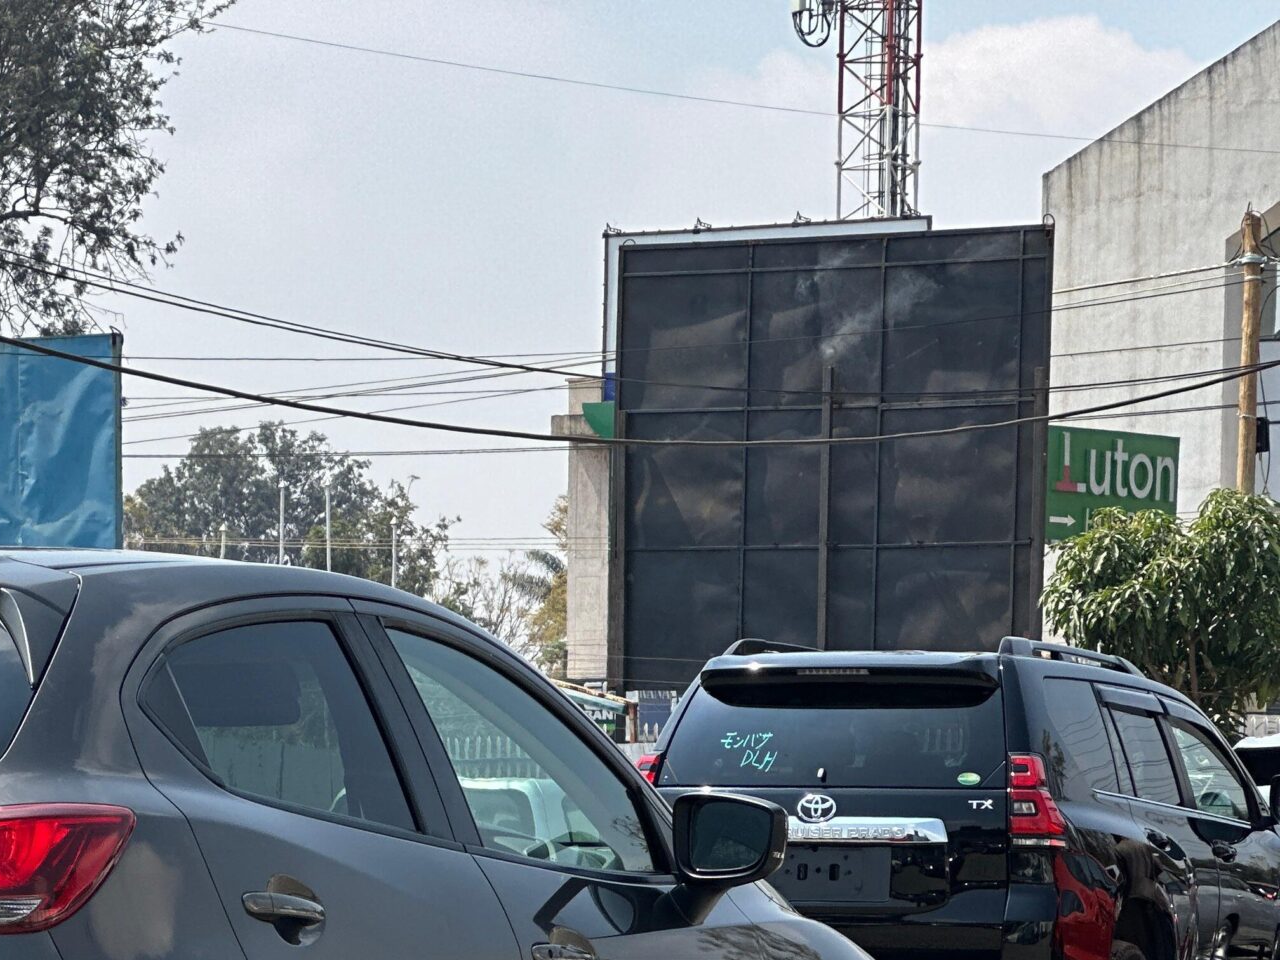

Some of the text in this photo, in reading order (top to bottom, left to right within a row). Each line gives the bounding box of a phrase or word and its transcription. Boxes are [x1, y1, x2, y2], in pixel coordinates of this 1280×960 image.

[1055, 431, 1175, 502] Luton
[967, 799, 994, 810] TX
[787, 826, 906, 839] RUISER PRADO
